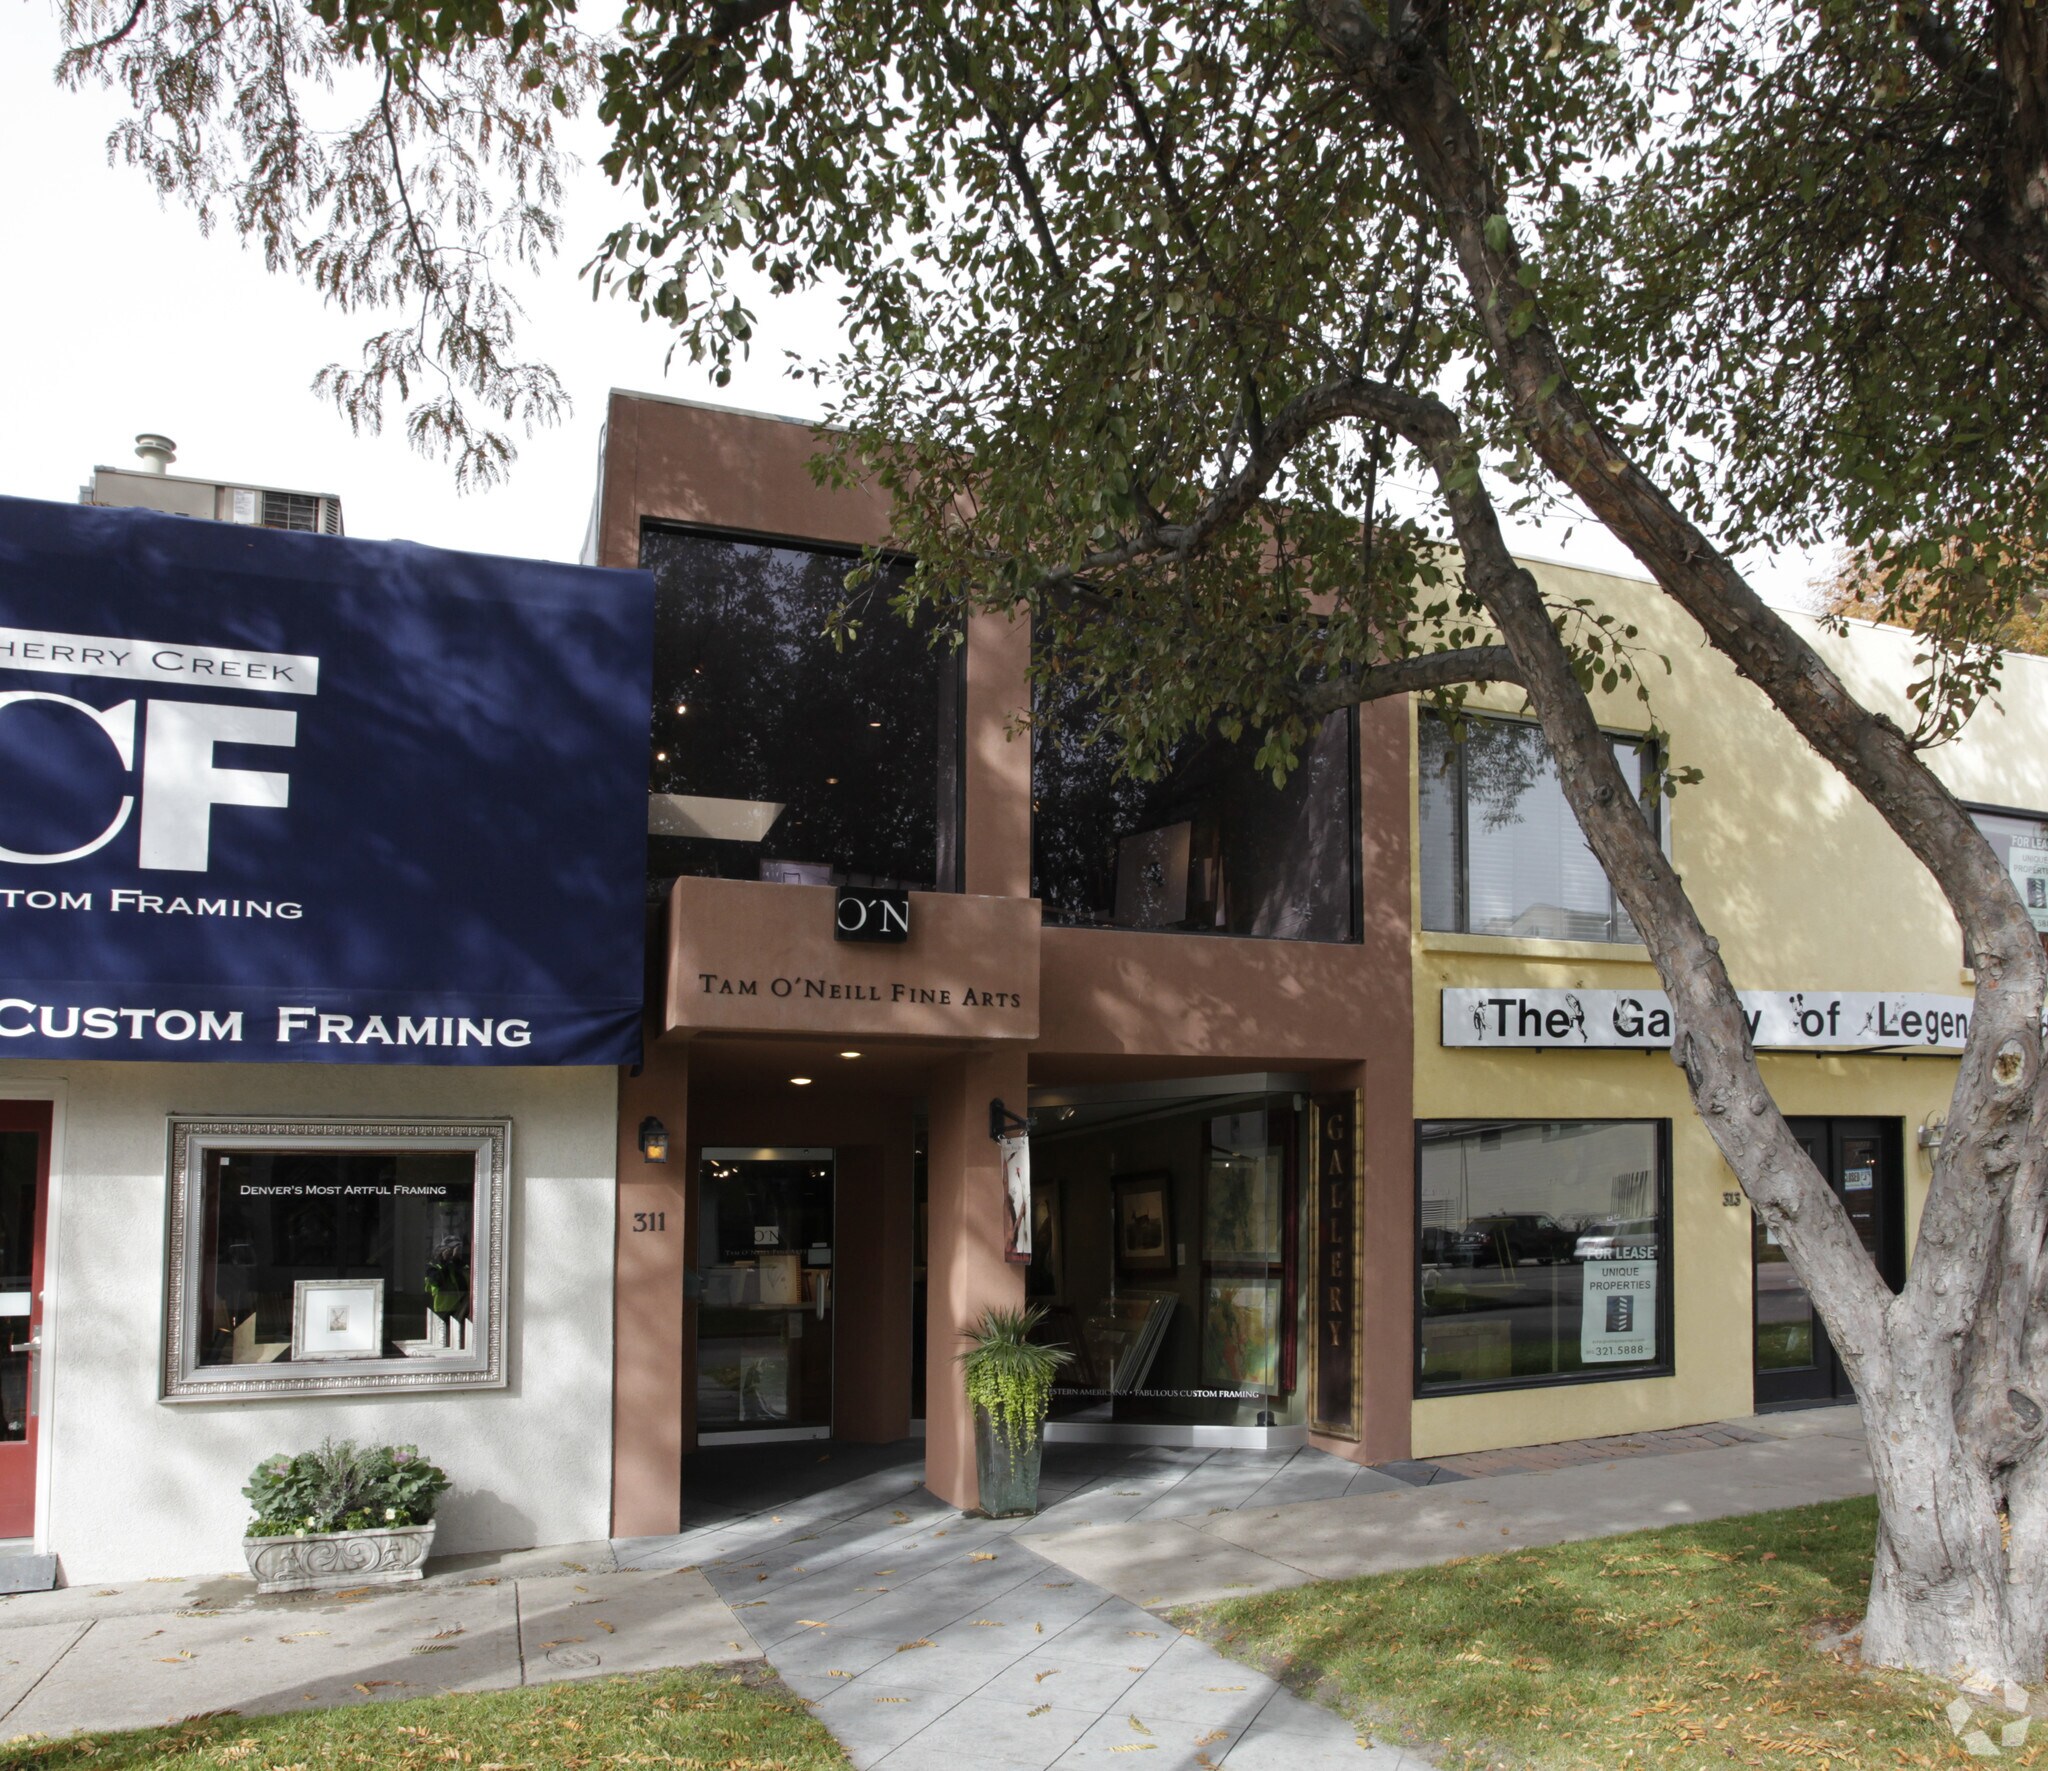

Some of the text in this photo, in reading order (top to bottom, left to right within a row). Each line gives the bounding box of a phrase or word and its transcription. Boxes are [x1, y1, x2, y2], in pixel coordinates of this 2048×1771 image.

[0, 640, 295, 682] HERRY CREEK
[2011, 835, 2048, 850] FOR LEA
[0, 889, 303, 920] TOM FRAMING
[698, 973, 1021, 1008] TAM O'NEILL FINE ARTS
[0, 998, 531, 1048] CUSTOM FRAMING
[1488, 998, 1569, 1037] The
[1800, 1000, 1841, 1037] of
[1878, 1001, 1968, 1045] Legen
[240, 1185, 447, 1195] DENVER'S MOST ARTFUL FRAMING
[632, 1211, 665, 1233] 311
[1326, 1113, 1344, 1347] GALLERY
[1586, 1246, 1655, 1260] FOR LEASE
[1602, 1266, 1640, 1277] UNIQUE
[1589, 1280, 1651, 1291] PROPERTIES
[1595, 1344, 1644, 1356] 321.5888
[1049, 1388, 1079, 1396] ESTERN
[1134, 1389, 1179, 1397] FABULOUS
[1179, 1389, 1218, 1398] CUSTOM
[1219, 1390, 1260, 1398] FRAMING
